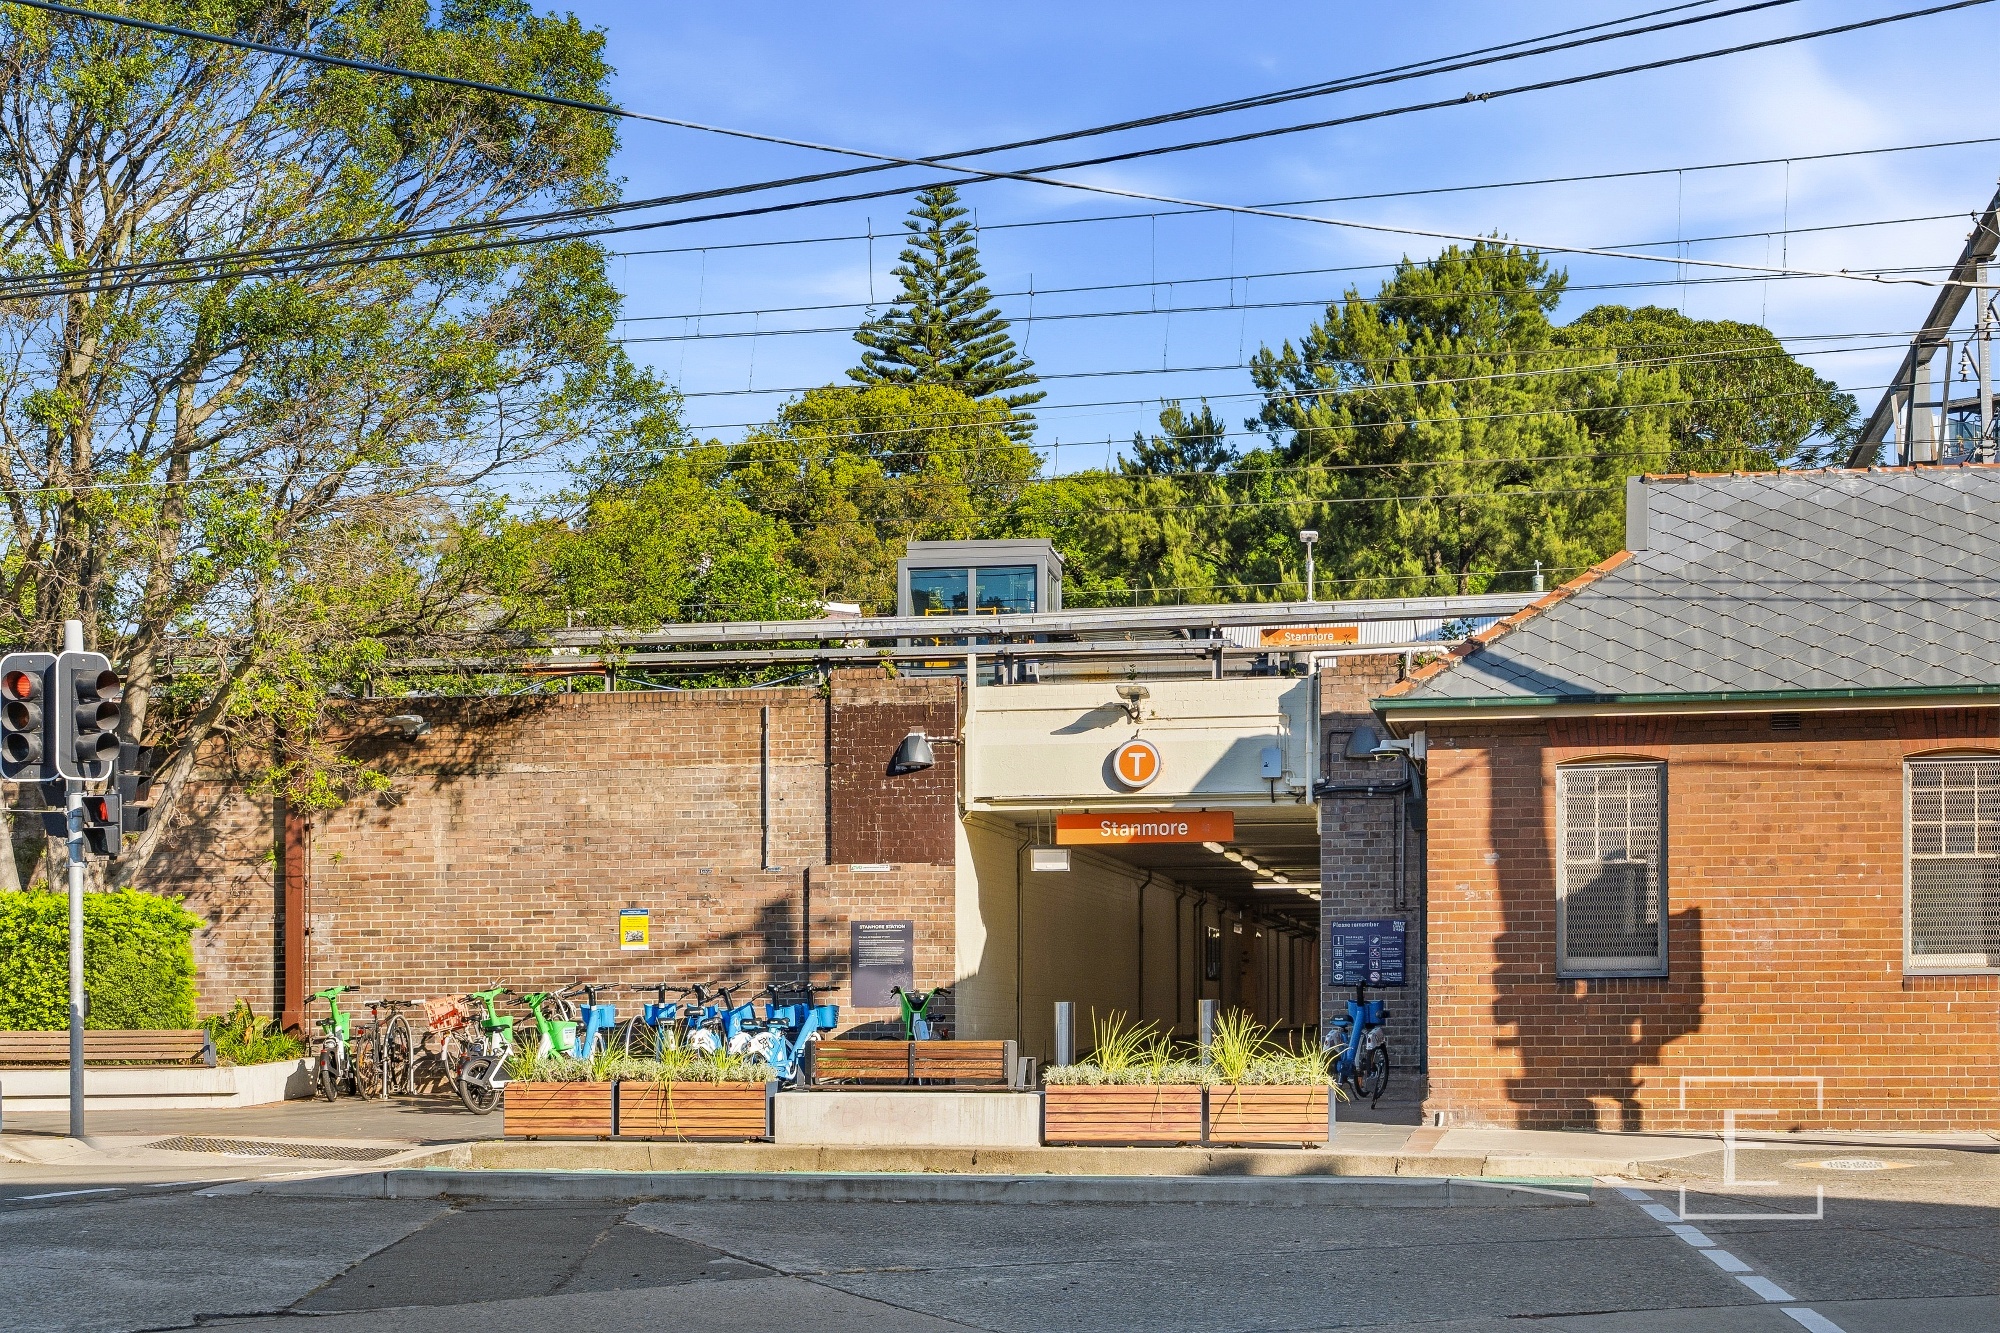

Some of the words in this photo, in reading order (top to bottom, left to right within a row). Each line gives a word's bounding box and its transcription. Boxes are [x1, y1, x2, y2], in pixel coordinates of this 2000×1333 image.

[1284, 632, 1334, 642] Stanmore
[1128, 752, 1147, 777] T
[1100, 820, 1189, 837] Stanmore
